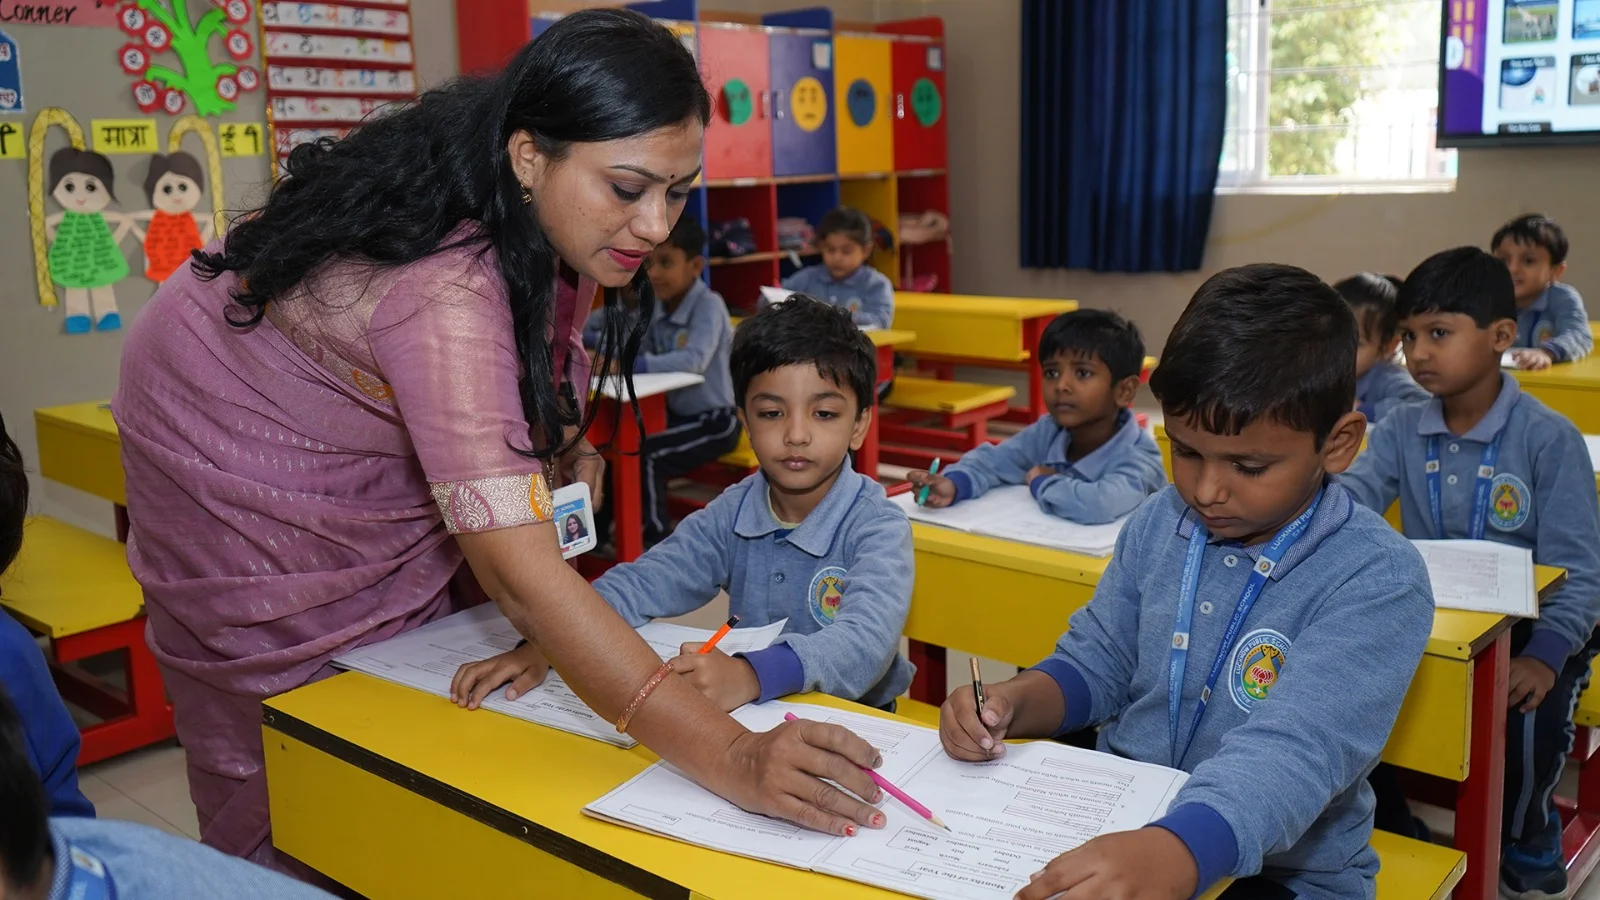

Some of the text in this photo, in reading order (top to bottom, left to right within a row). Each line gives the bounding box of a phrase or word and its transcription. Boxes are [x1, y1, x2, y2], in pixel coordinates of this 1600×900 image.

[101, 125, 151, 147] मात्रा
[1270, 518, 1302, 551] LUCKNOW
[1176, 524, 1200, 622] LUCKNOW PUBLIC SCHOOL
[1210, 581, 1256, 678] LUCKNOW PUBLIC SCHOOL
[1236, 636, 1287, 675] LUCKNOW PUBLIC SCHO
[1168, 659, 1177, 691] SCHOOL
[572, 710, 593, 719] Months
[1010, 764, 1041, 775] celebrate
[990, 777, 1015, 787] Gandhi
[1059, 774, 1080, 782] which
[1089, 780, 1112, 788] month
[1015, 784, 1046, 794] Mahatma
[1048, 790, 1069, 798] which
[1078, 796, 1102, 804] month
[945, 808, 973, 818] vacation
[1044, 807, 1067, 816] before
[1068, 812, 1092, 820] month
[975, 815, 1003, 825] summer
[758, 829, 779, 837] month
[1022, 826, 1044, 835] which
[1054, 832, 1078, 841] month
[903, 829, 1021, 859] October November December
[907, 838, 930, 846] August
[1010, 840, 1032, 849] which
[938, 853, 960, 861] March
[918, 866, 938, 874] Year
[977, 862, 1009, 872] February
[941, 871, 957, 879] the
[970, 878, 1005, 890] Months
